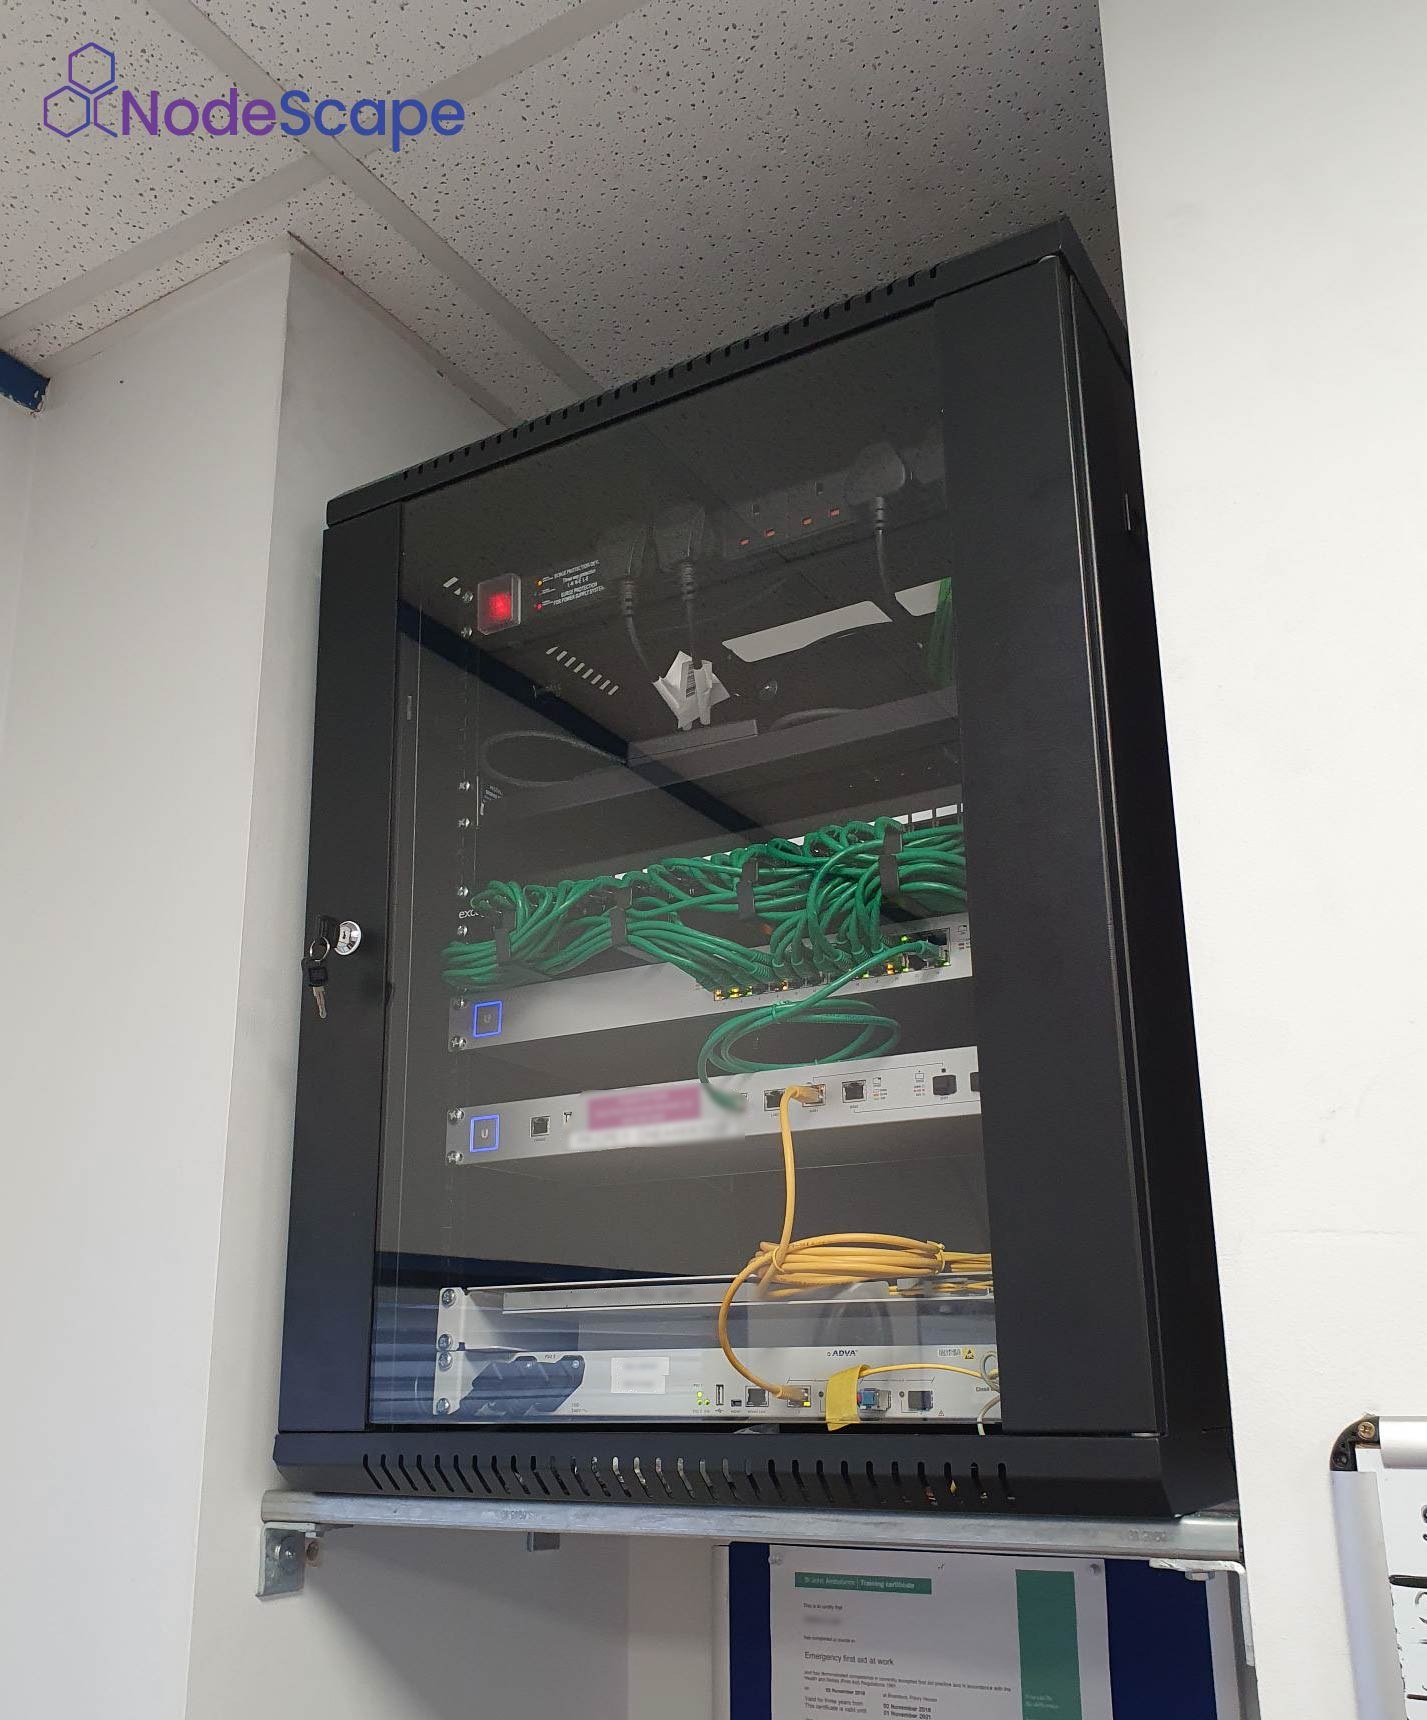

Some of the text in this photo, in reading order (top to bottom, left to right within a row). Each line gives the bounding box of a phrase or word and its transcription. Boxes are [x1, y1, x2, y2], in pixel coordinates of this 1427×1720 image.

[860, 1580, 885, 1588] Training
[804, 1651, 841, 1663] Emergency
[843, 1654, 856, 1663] first
[869, 1656, 876, 1664] at
[891, 1704, 917, 1712] November
[891, 1711, 917, 1719] November
